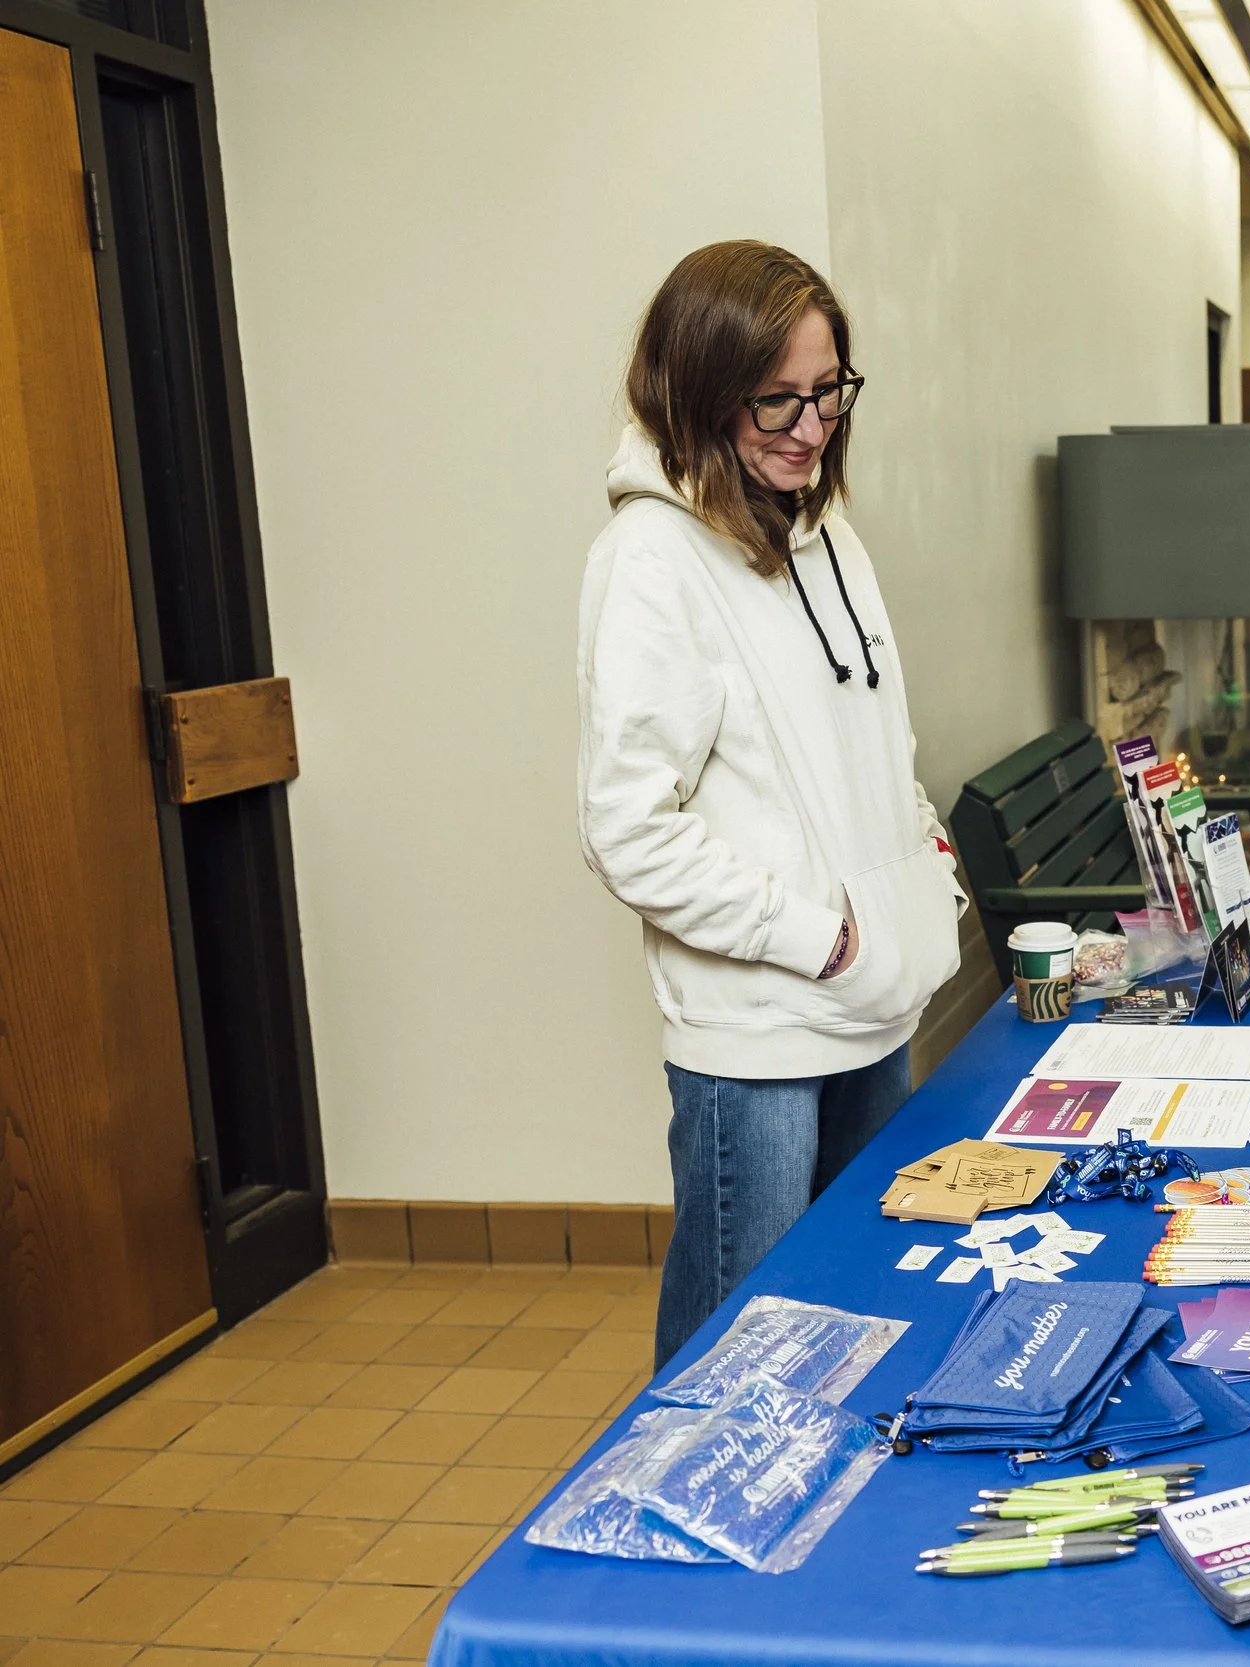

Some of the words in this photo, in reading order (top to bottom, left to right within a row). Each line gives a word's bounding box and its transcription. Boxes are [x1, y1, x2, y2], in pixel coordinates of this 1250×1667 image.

[710, 1333, 757, 1375] mental
[994, 1355, 1031, 1390] you
[1024, 1302, 1068, 1355] matter
[688, 1431, 742, 1490] mental
[729, 1466, 749, 1483] is
[1173, 1509, 1206, 1523] YOU
[1212, 1500, 1240, 1513] ARE
